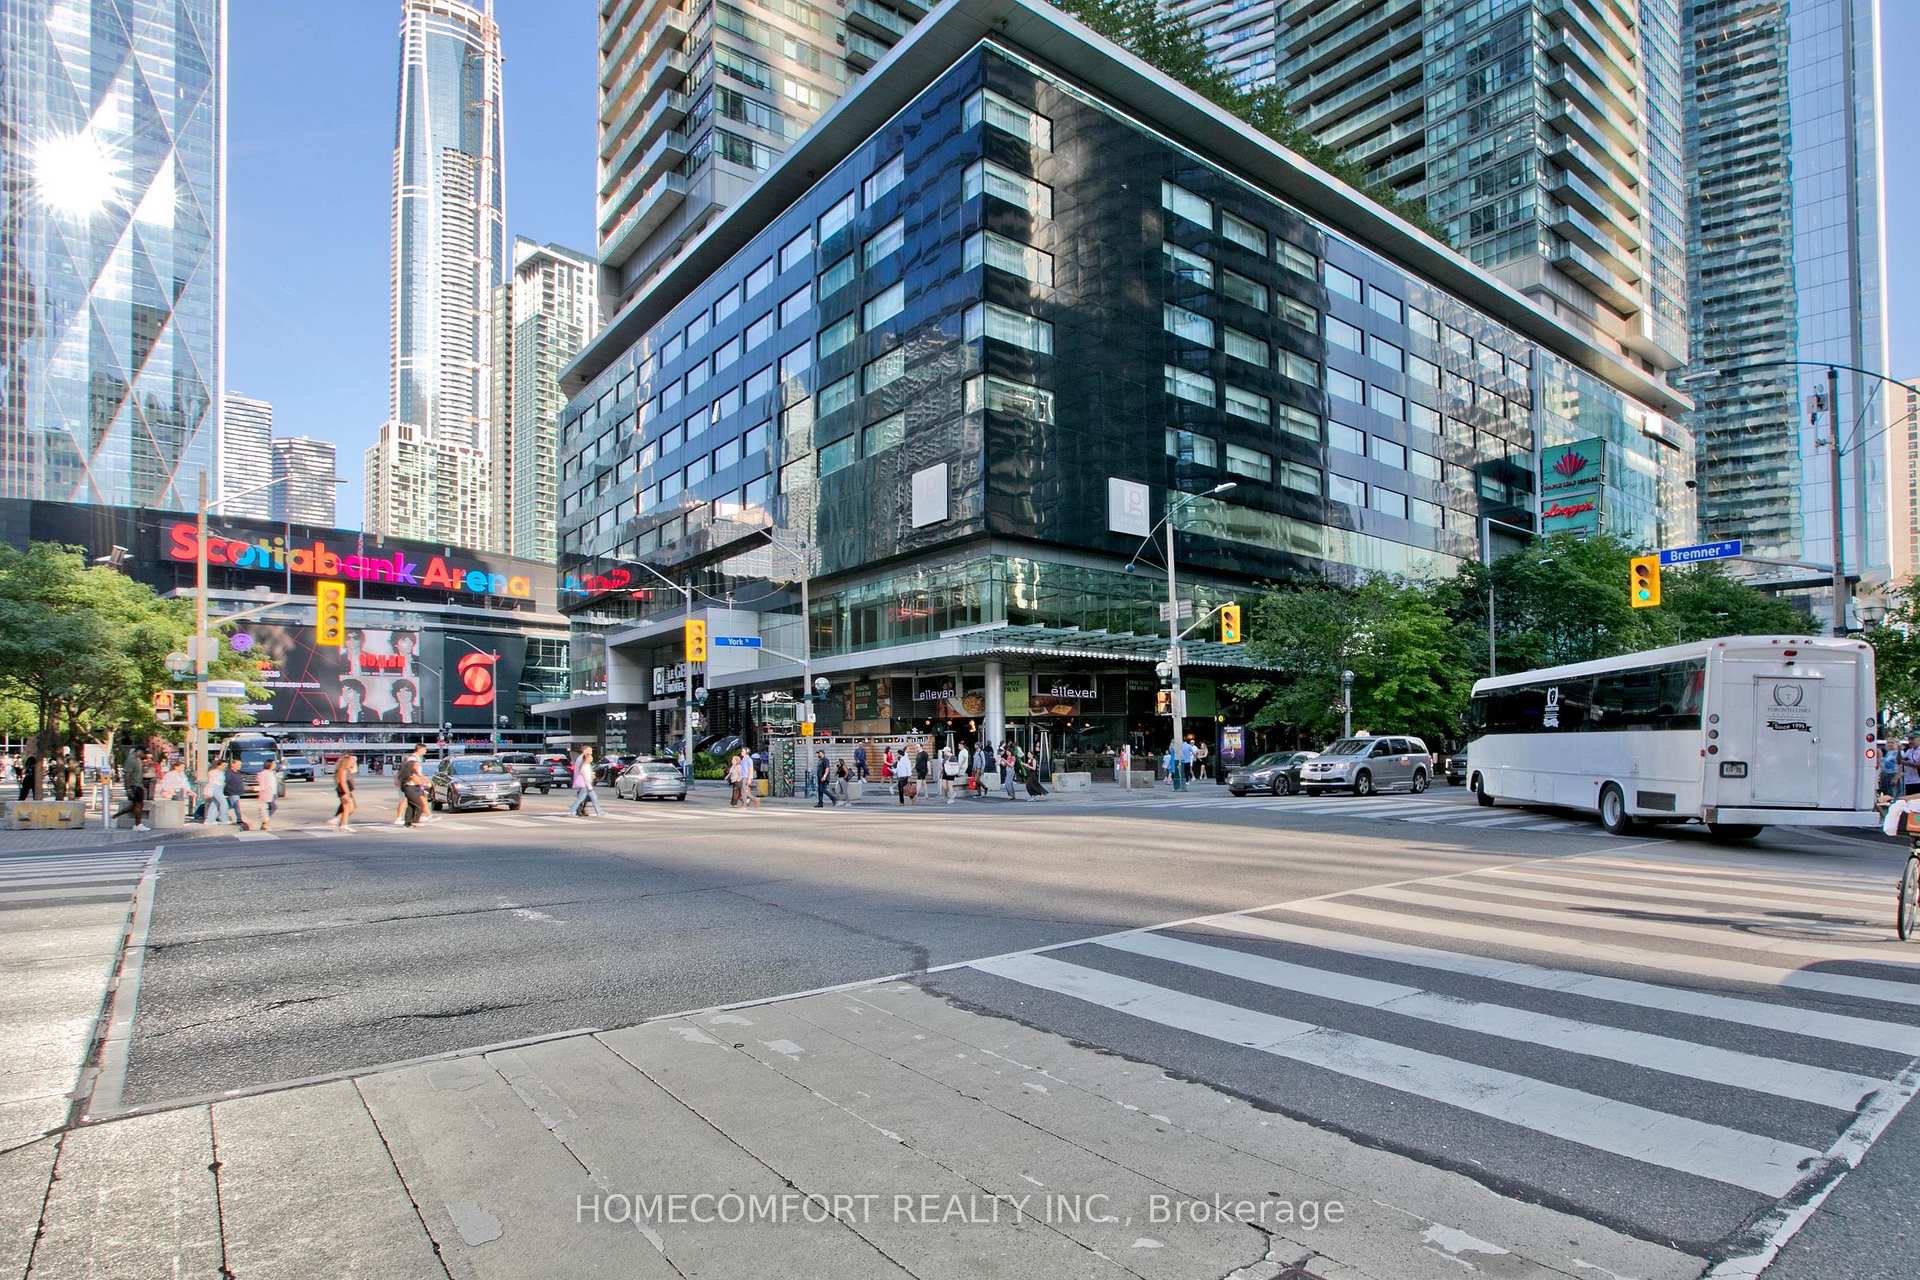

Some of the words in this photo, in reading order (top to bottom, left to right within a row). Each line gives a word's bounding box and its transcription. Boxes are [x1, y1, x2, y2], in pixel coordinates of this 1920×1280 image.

[170, 522, 417, 586] Scotiabank
[422, 555, 531, 597] Arena
[1670, 546, 1721, 561] Bremner
[728, 638, 744, 646] York
[919, 688, 955, 700] elleven
[1050, 686, 1098, 699] elleven
